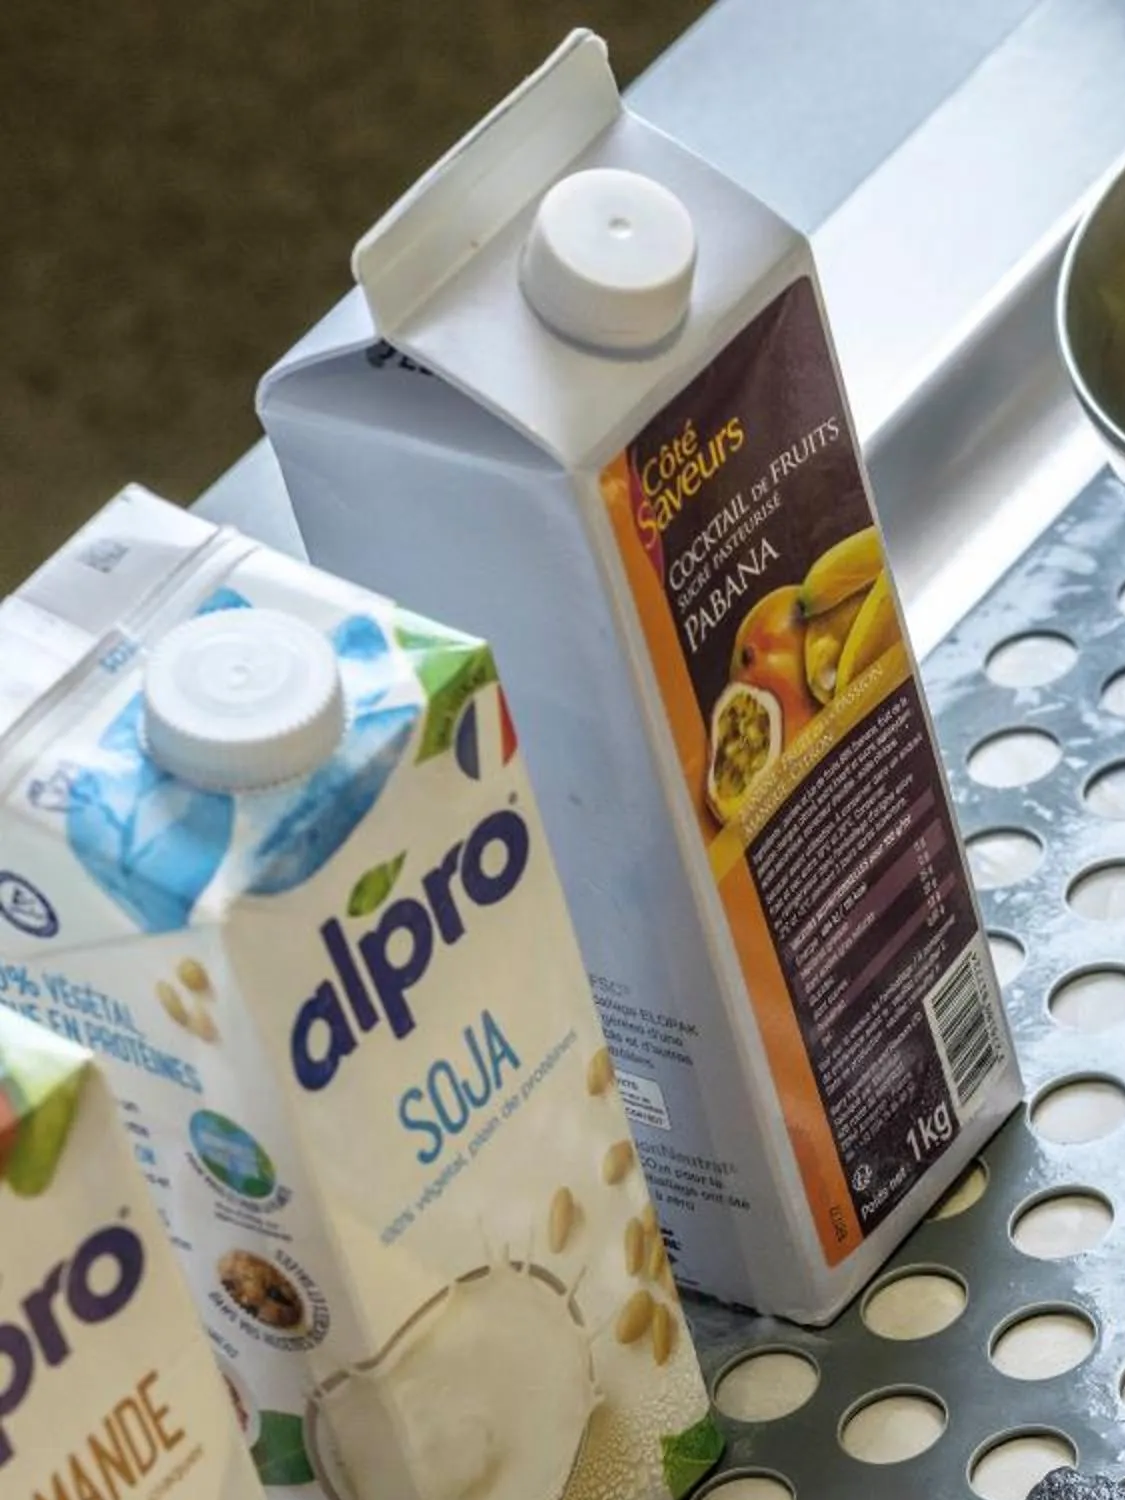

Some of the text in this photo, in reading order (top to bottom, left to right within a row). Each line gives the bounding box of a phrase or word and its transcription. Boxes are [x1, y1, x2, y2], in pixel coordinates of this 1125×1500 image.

[637, 416, 745, 549] Saveurs
[642, 419, 699, 496] Côté
[669, 415, 839, 591] COCKTAIL DE FRUITS
[683, 536, 780, 653] PABANA
[291, 808, 530, 1091] alpro
[397, 1007, 522, 1166] SOJA
[905, 1101, 954, 1162] 1kg
